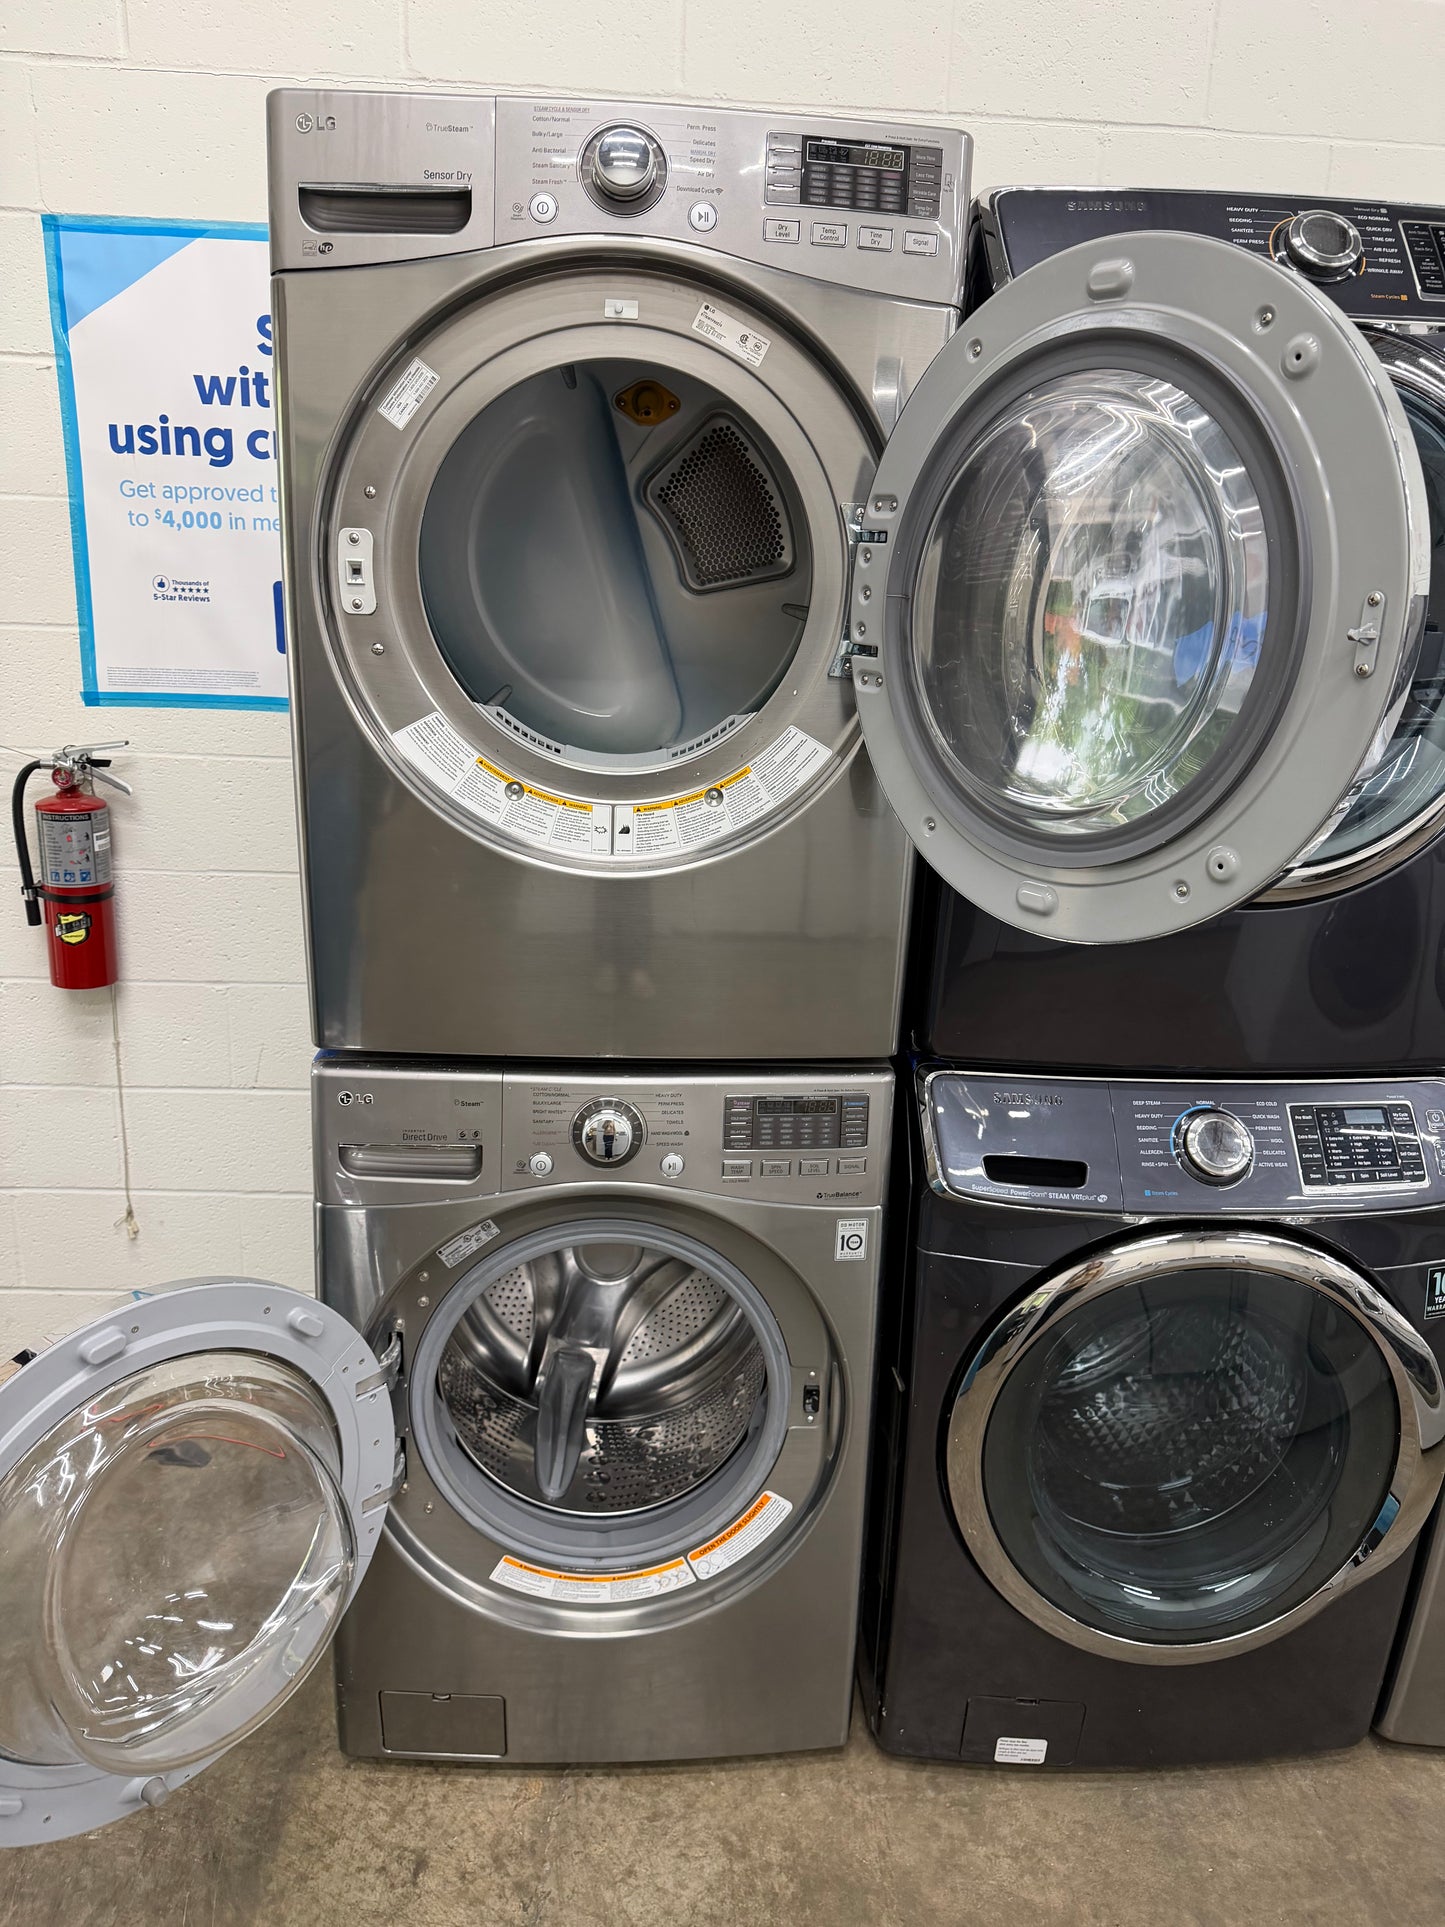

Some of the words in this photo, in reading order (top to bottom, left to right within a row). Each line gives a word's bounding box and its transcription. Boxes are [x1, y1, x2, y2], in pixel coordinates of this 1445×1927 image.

[316, 116, 336, 130] LG
[693, 139, 716, 147] Delicates
[424, 170, 454, 180] Sensor
[457, 171, 472, 181] Dry
[775, 230, 790, 238] Level
[819, 234, 839, 242] Control
[870, 238, 881, 246] Dry
[912, 238, 929, 247] Signal
[108, 414, 233, 468] using
[247, 429, 277, 460] c
[119, 479, 157, 498] Get
[162, 484, 264, 504] approved
[128, 510, 149, 527] to
[154, 508, 222, 532] $4,000
[228, 512, 246, 530] in
[153, 593, 177, 601] 5-Star
[178, 594, 211, 603] Reviews
[43, 814, 90, 822] INSTRUCTIONS
[355, 1093, 374, 1105] LG
[402, 1132, 426, 1141] Direct
[427, 1133, 448, 1141] Drive
[971, 1184, 1009, 1194] SuperSpeed
[1047, 1192, 1070, 1200] STEAM
[840, 1234, 863, 1251] 10
[699, 1544, 716, 1555] OPEN
[715, 1535, 728, 1546] THE
[726, 1523, 743, 1538] DOOR
[741, 1501, 765, 1524] SLIGHTLY
